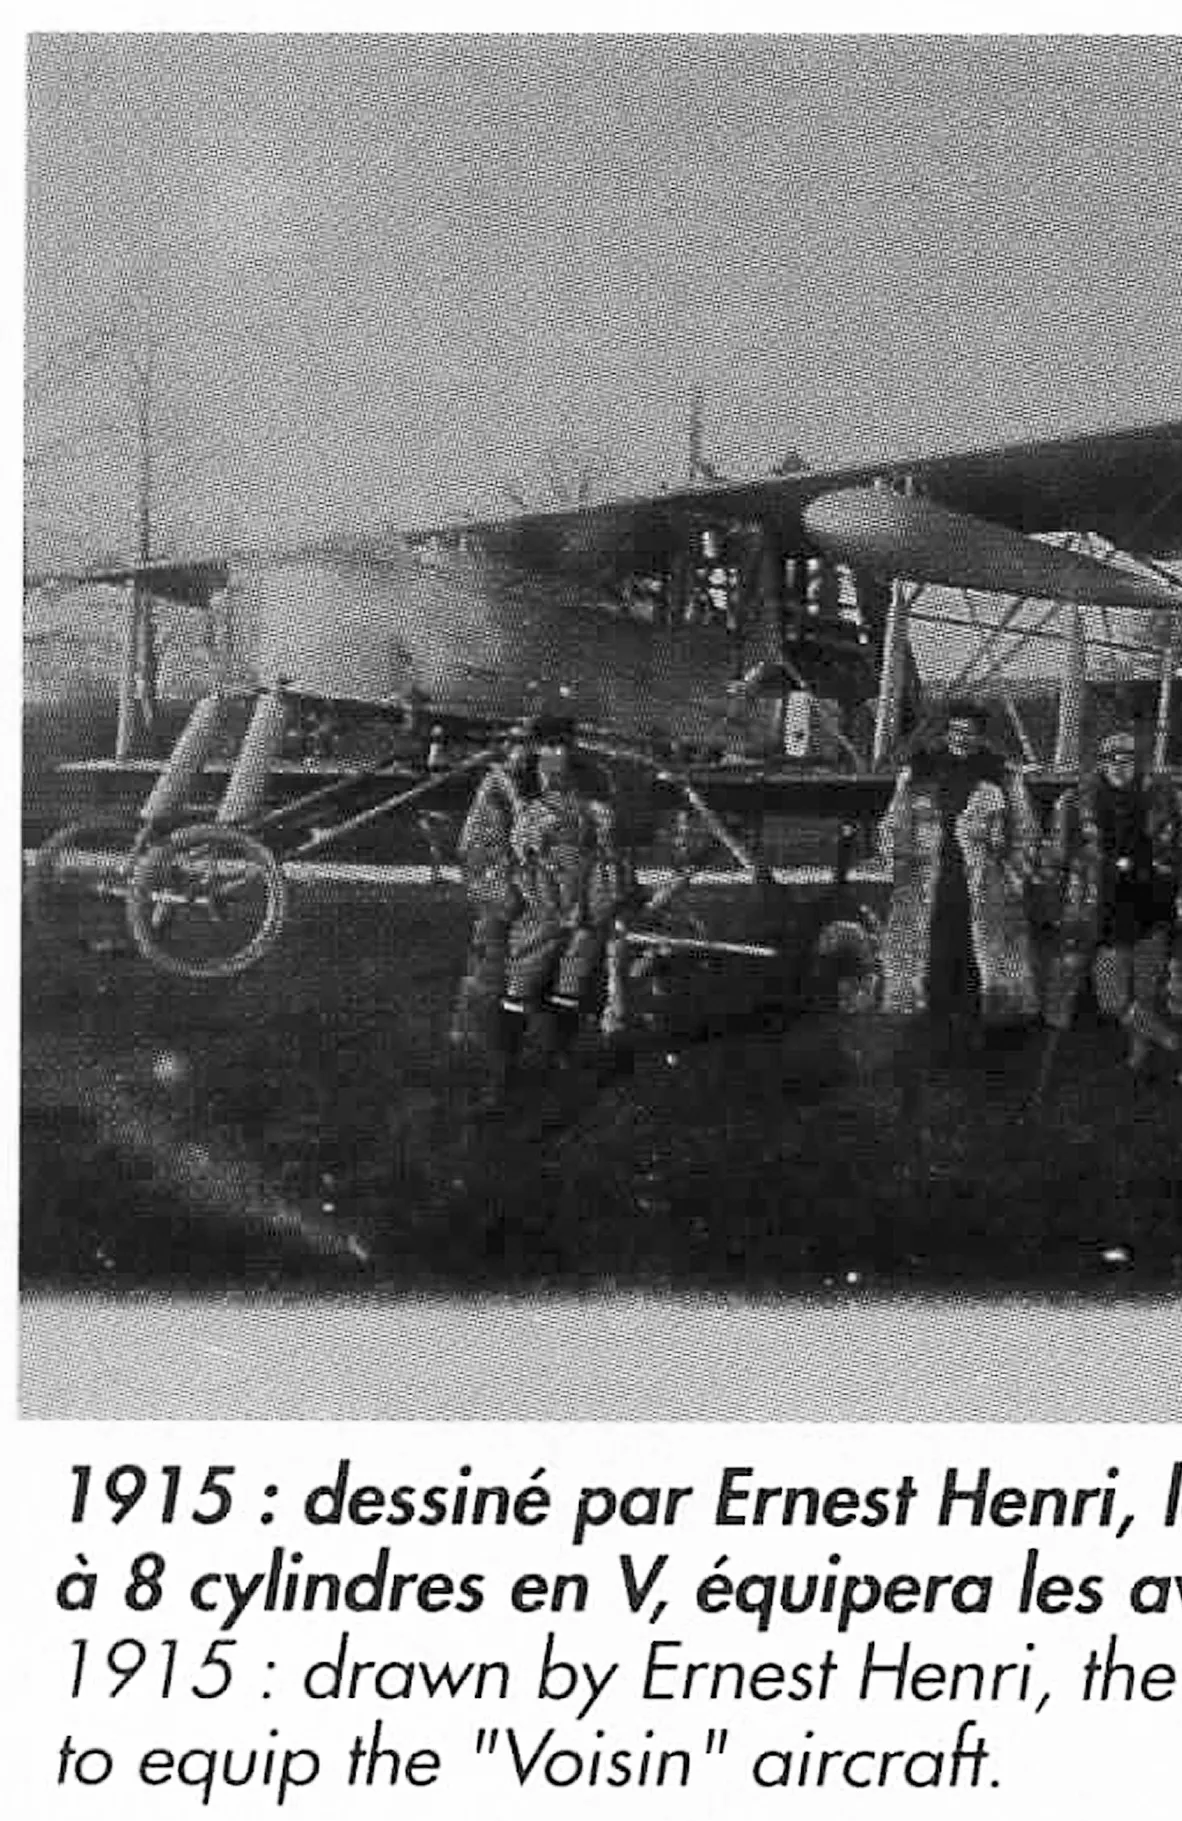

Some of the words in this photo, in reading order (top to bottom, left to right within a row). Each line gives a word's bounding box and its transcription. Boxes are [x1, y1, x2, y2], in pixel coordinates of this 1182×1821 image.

[72, 1465, 235, 1524] 1915
[261, 1485, 277, 1524] :
[305, 1459, 550, 1525] dessiné
[573, 1487, 693, 1545] par
[716, 1467, 917, 1527] Ernest
[939, 1467, 1134, 1538] Henri,
[57, 1553, 97, 1610] à
[125, 1552, 165, 1611] 8
[191, 1547, 484, 1631] cylindres
[512, 1574, 588, 1612] en
[620, 1554, 668, 1624] V,
[697, 1553, 992, 1632] équipera
[1019, 1548, 1103, 1614] les
[72, 1639, 236, 1698] 1915
[263, 1662, 274, 1698] :
[304, 1632, 509, 1699] drawn
[538, 1632, 618, 1720] by
[643, 1641, 837, 1701] Ernest
[860, 1641, 1049, 1713] Henri,
[1084, 1634, 1175, 1701] the
[58, 1736, 112, 1785] to
[140, 1729, 319, 1806] equip
[349, 1719, 440, 1786] the
[477, 1728, 727, 1787] "Voisin"
[753, 1720, 999, 1788] aircraft.
